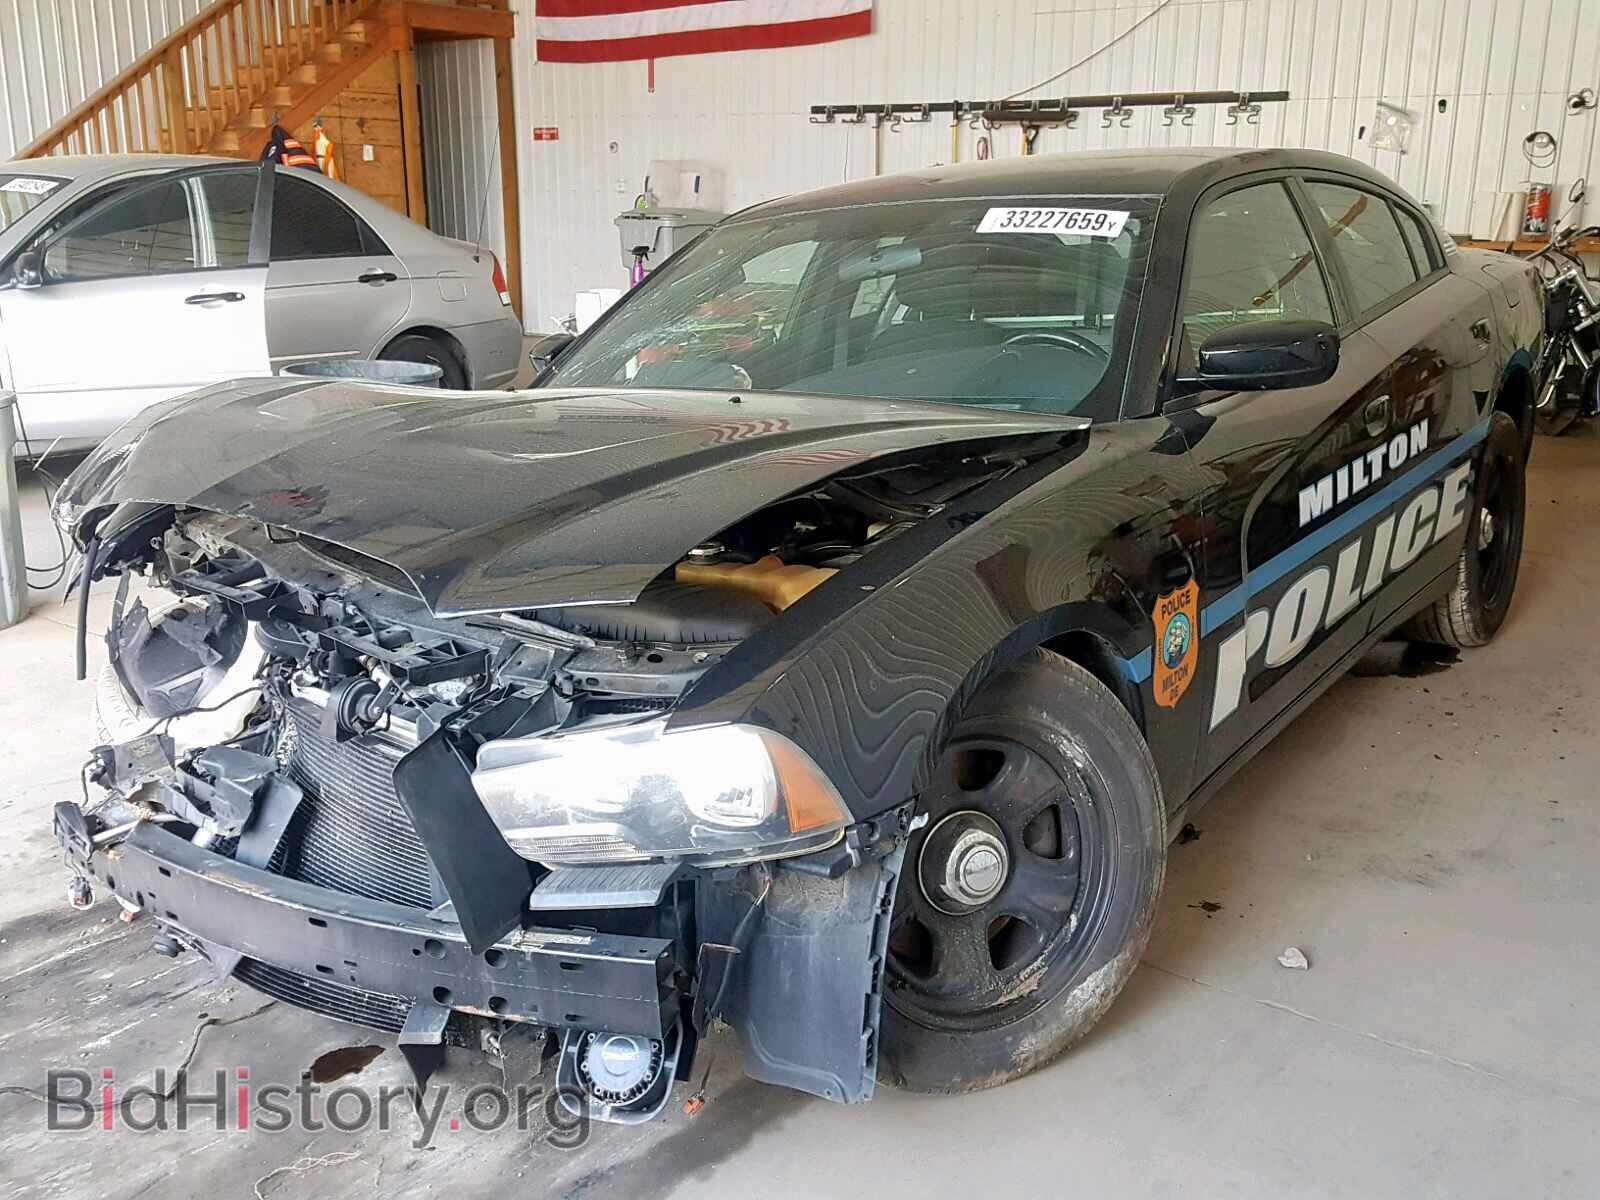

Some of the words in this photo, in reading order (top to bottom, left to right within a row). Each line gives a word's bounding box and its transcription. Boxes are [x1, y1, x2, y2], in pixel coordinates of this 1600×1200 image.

[1299, 418, 1429, 528] MILTON
[1161, 589, 1191, 620] POLICE
[1208, 460, 1472, 734] POLICE
[1162, 662, 1189, 694] MILTON
